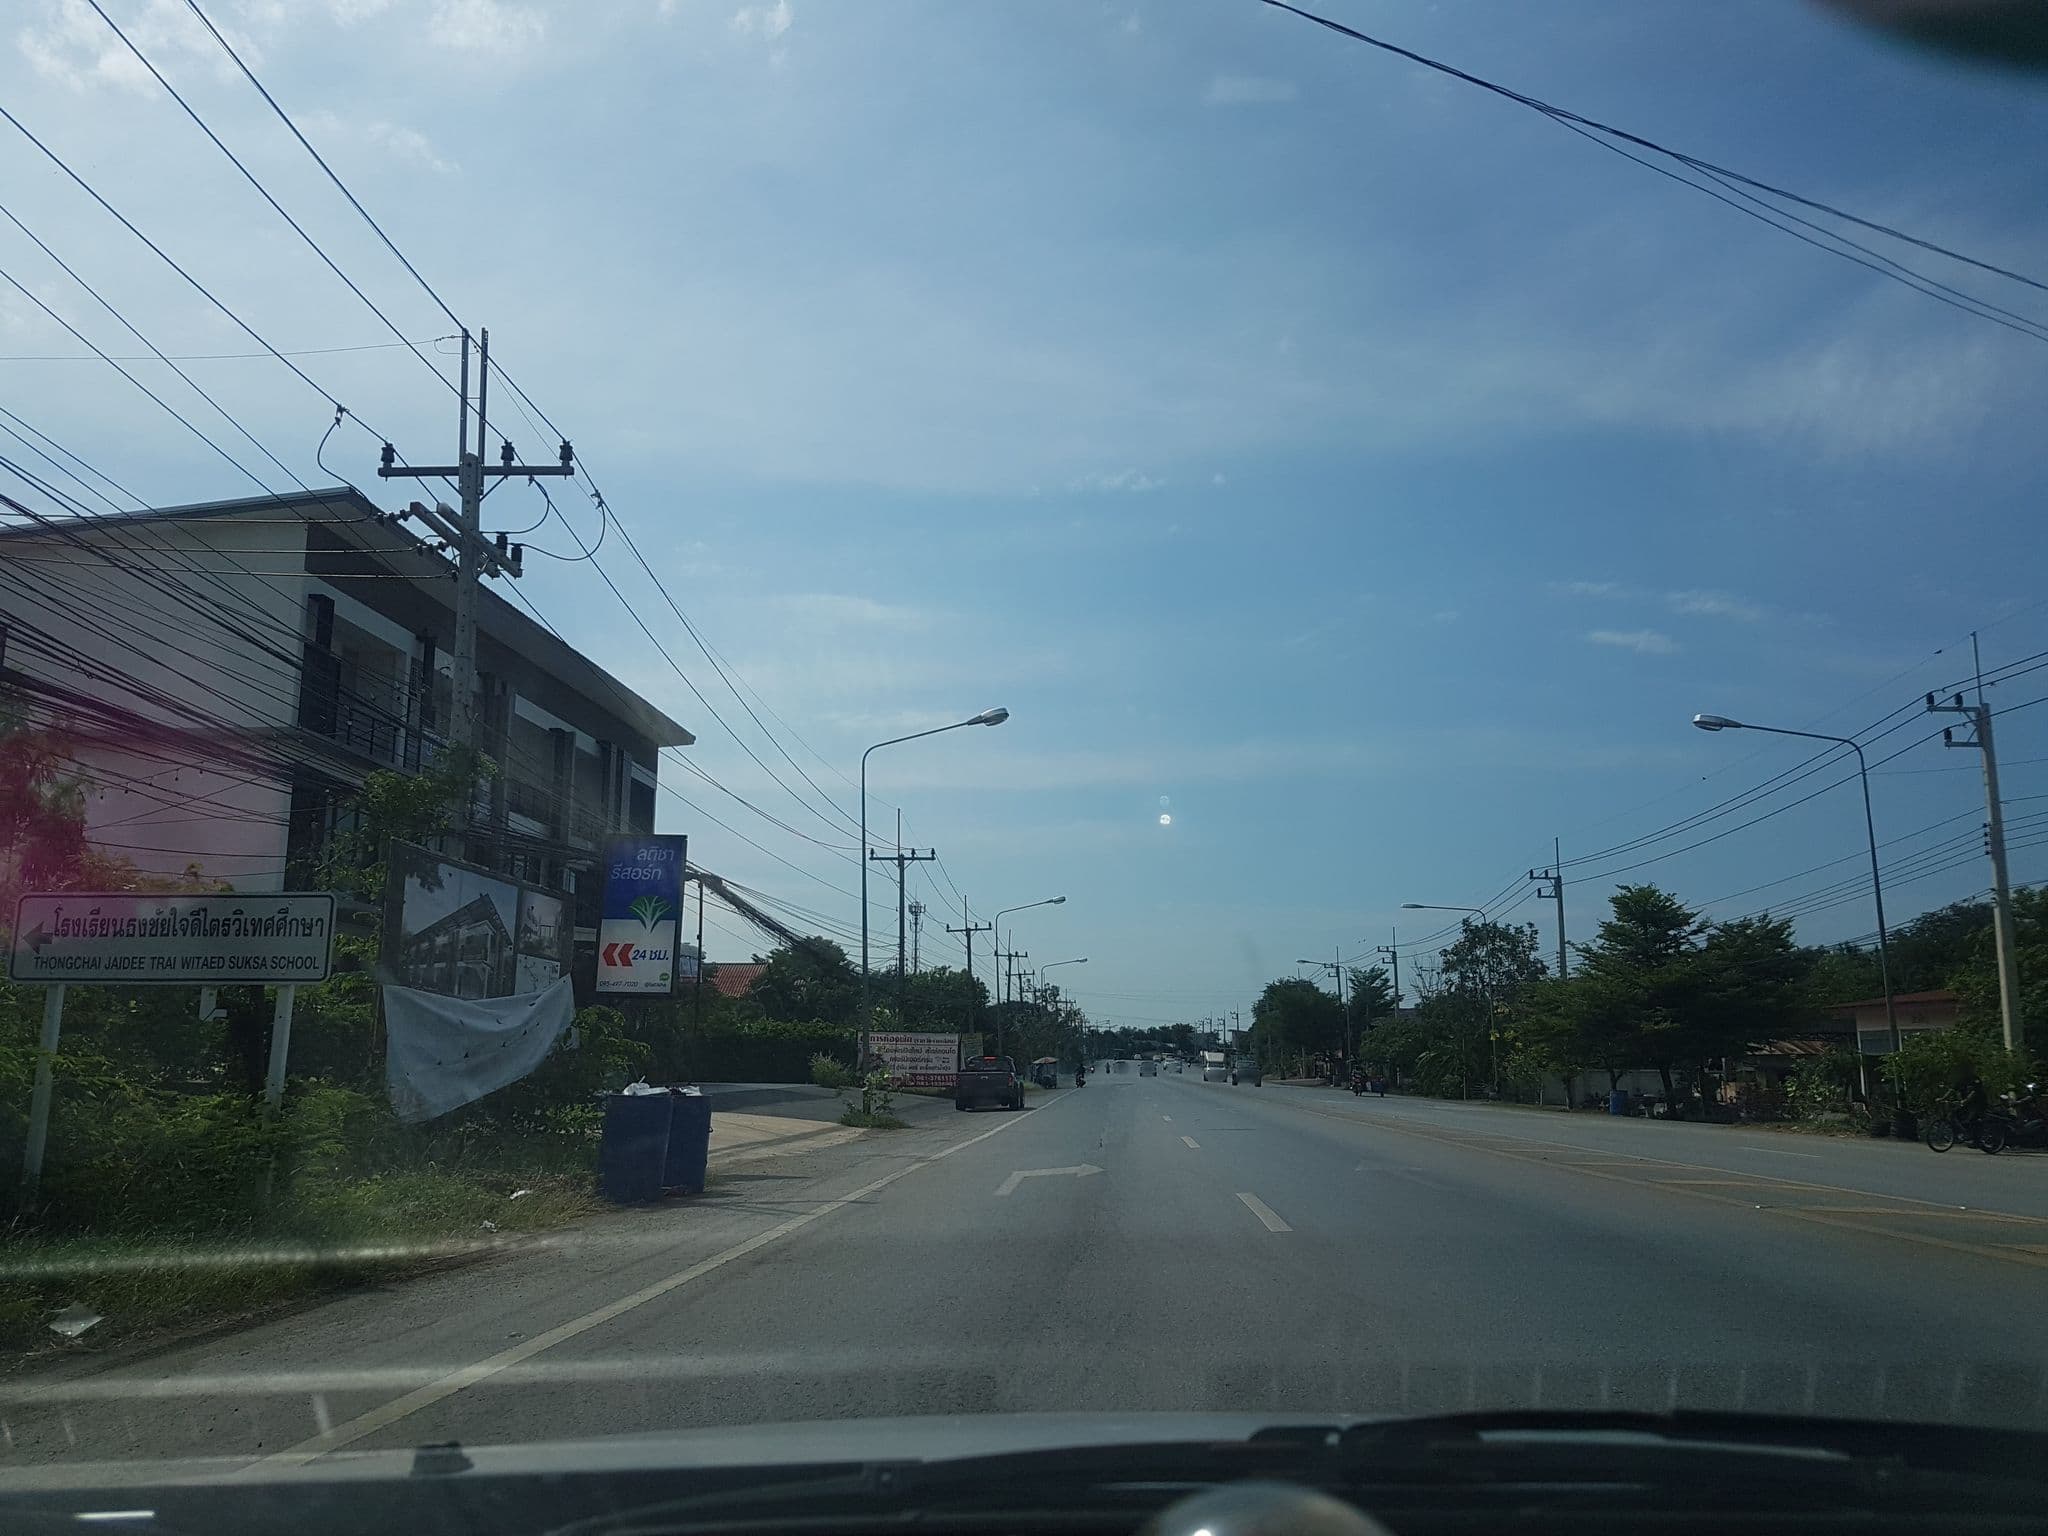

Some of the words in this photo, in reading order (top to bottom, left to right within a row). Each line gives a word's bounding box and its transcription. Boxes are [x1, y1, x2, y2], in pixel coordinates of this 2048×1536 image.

[54, 906, 325, 938] โรงเรียนธงชัยใจดีไตรวิเทศศึกษา
[632, 949, 646, 960] 24
[649, 949, 669, 960] ชม.
[33, 956, 101, 970] THONGCHAI
[104, 956, 146, 970] JAIDEE
[150, 956, 177, 970] TRAI
[181, 955, 225, 970] WITAED
[228, 955, 268, 970] SUKSA
[270, 955, 320, 970] SCHOOL
